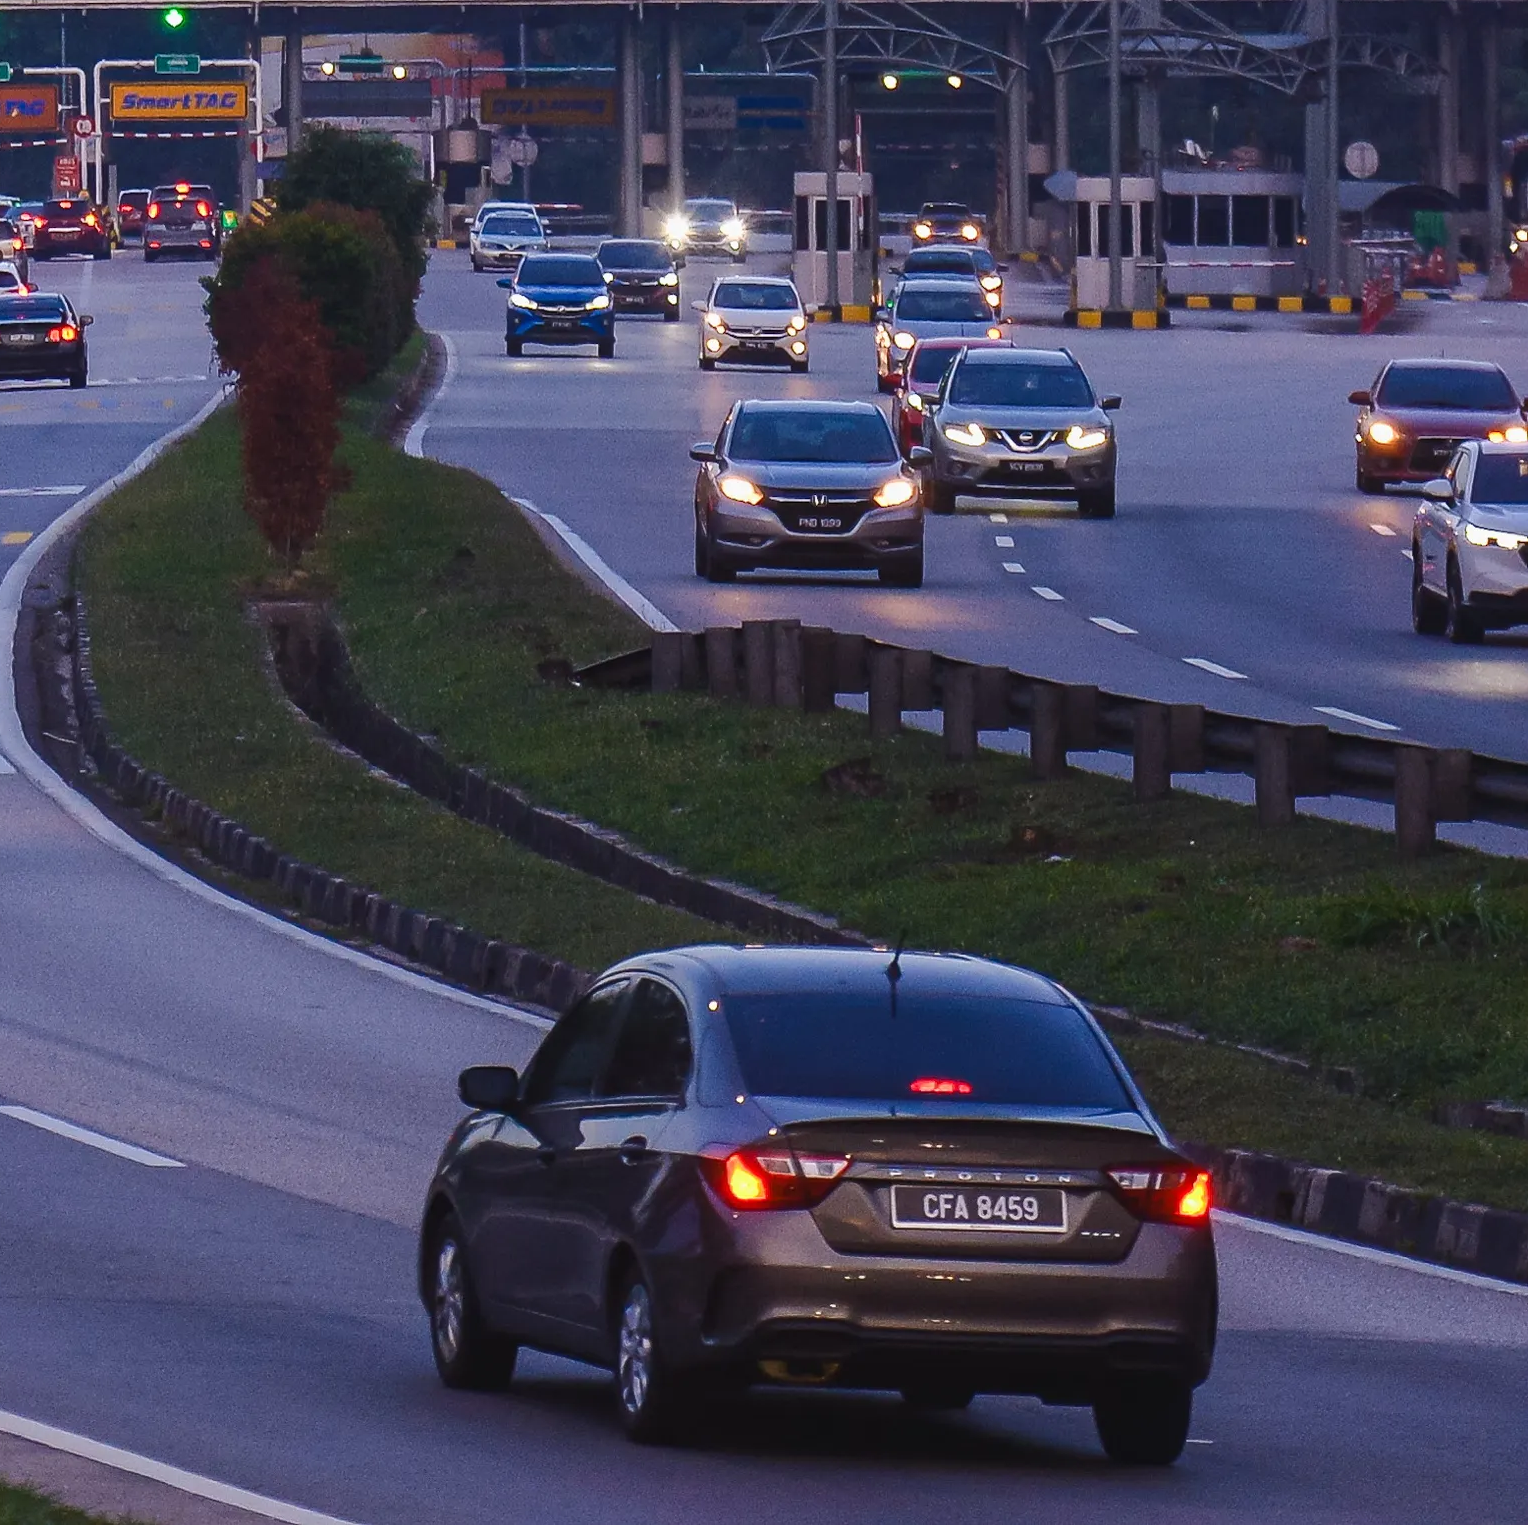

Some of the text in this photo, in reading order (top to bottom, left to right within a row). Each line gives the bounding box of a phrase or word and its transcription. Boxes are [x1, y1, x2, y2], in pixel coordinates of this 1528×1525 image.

[889, 1169, 1072, 1184] PROTON
[923, 1194, 1040, 1222] CFA 8459
